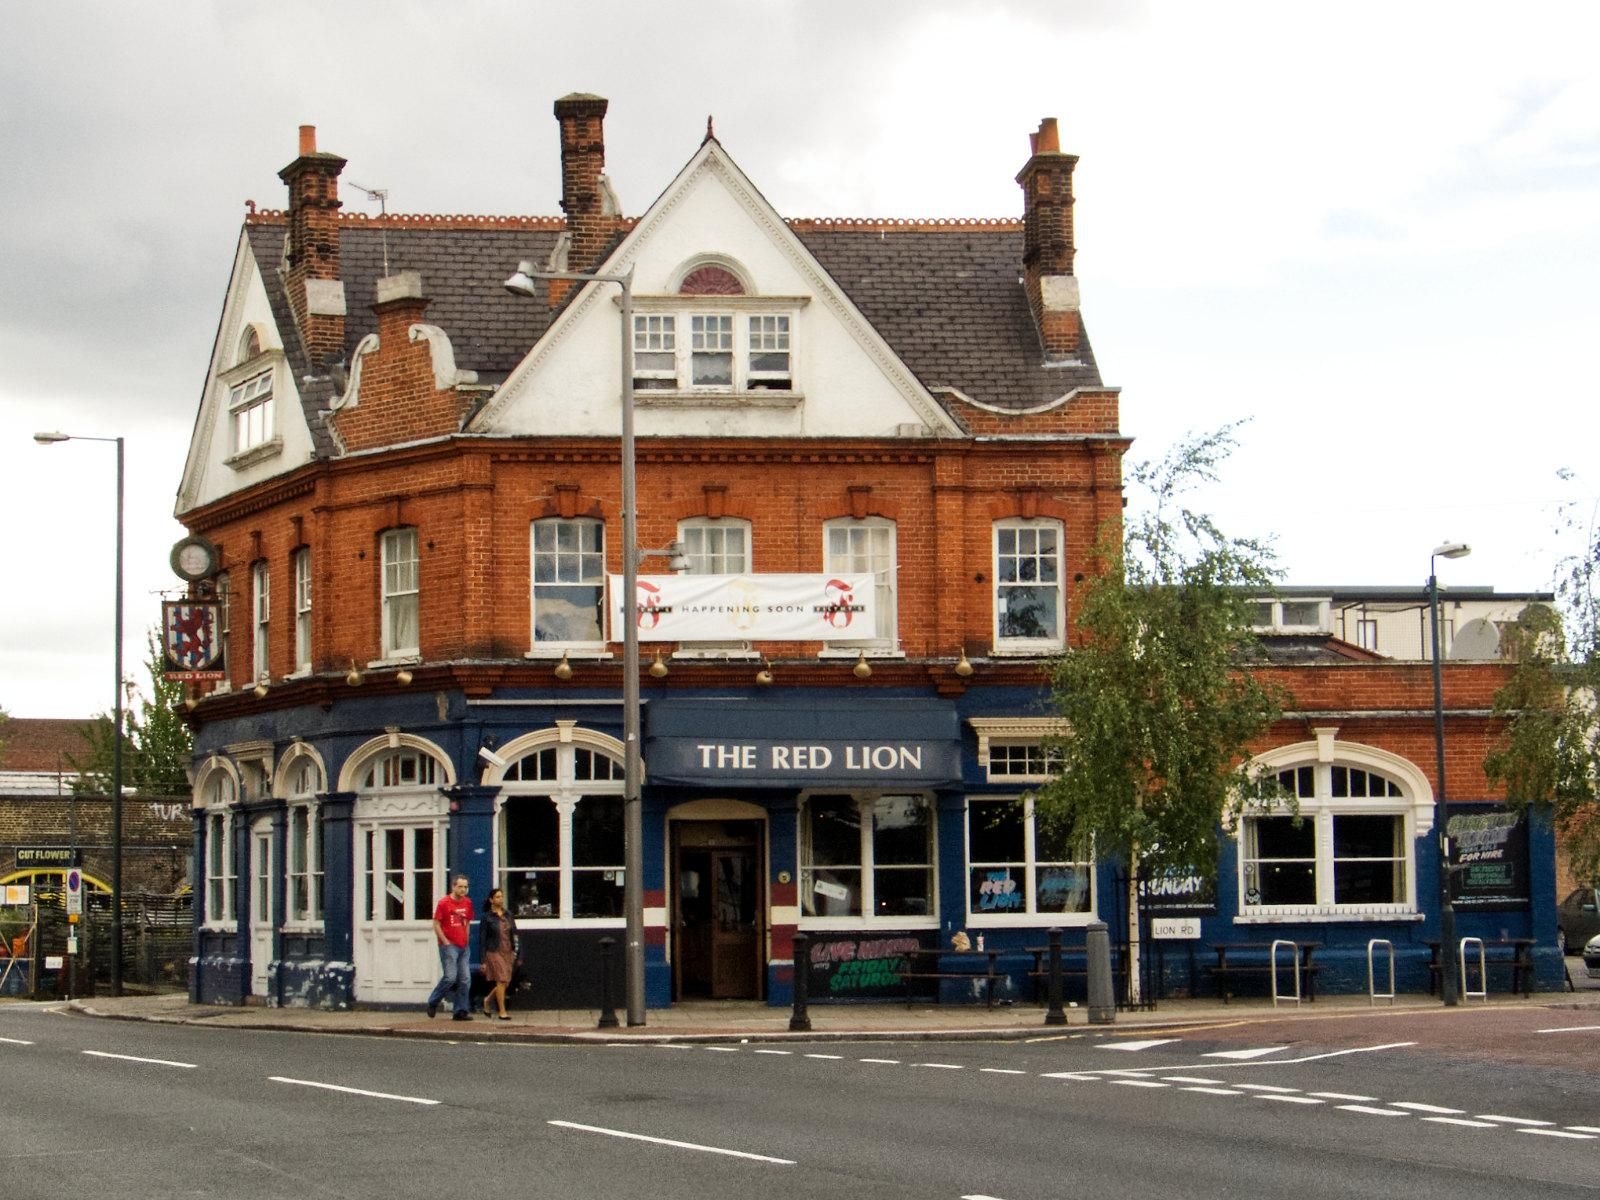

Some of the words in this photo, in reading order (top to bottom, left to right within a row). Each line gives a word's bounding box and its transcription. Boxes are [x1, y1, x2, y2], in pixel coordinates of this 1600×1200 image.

[767, 605, 804, 613] SOON
[697, 745, 757, 768] THE
[772, 746, 832, 769] RED
[846, 746, 921, 769] LION
[18, 850, 34, 859] CUT
[1459, 852, 1481, 863] FOR
[1480, 849, 1504, 859] HIRE
[979, 880, 1017, 895] RED
[1140, 875, 1203, 896] SUNDAY
[979, 893, 1023, 909] LION
[1155, 926, 1175, 935] LION
[810, 941, 857, 962] LIVE
[839, 956, 898, 974] FRIDAY
